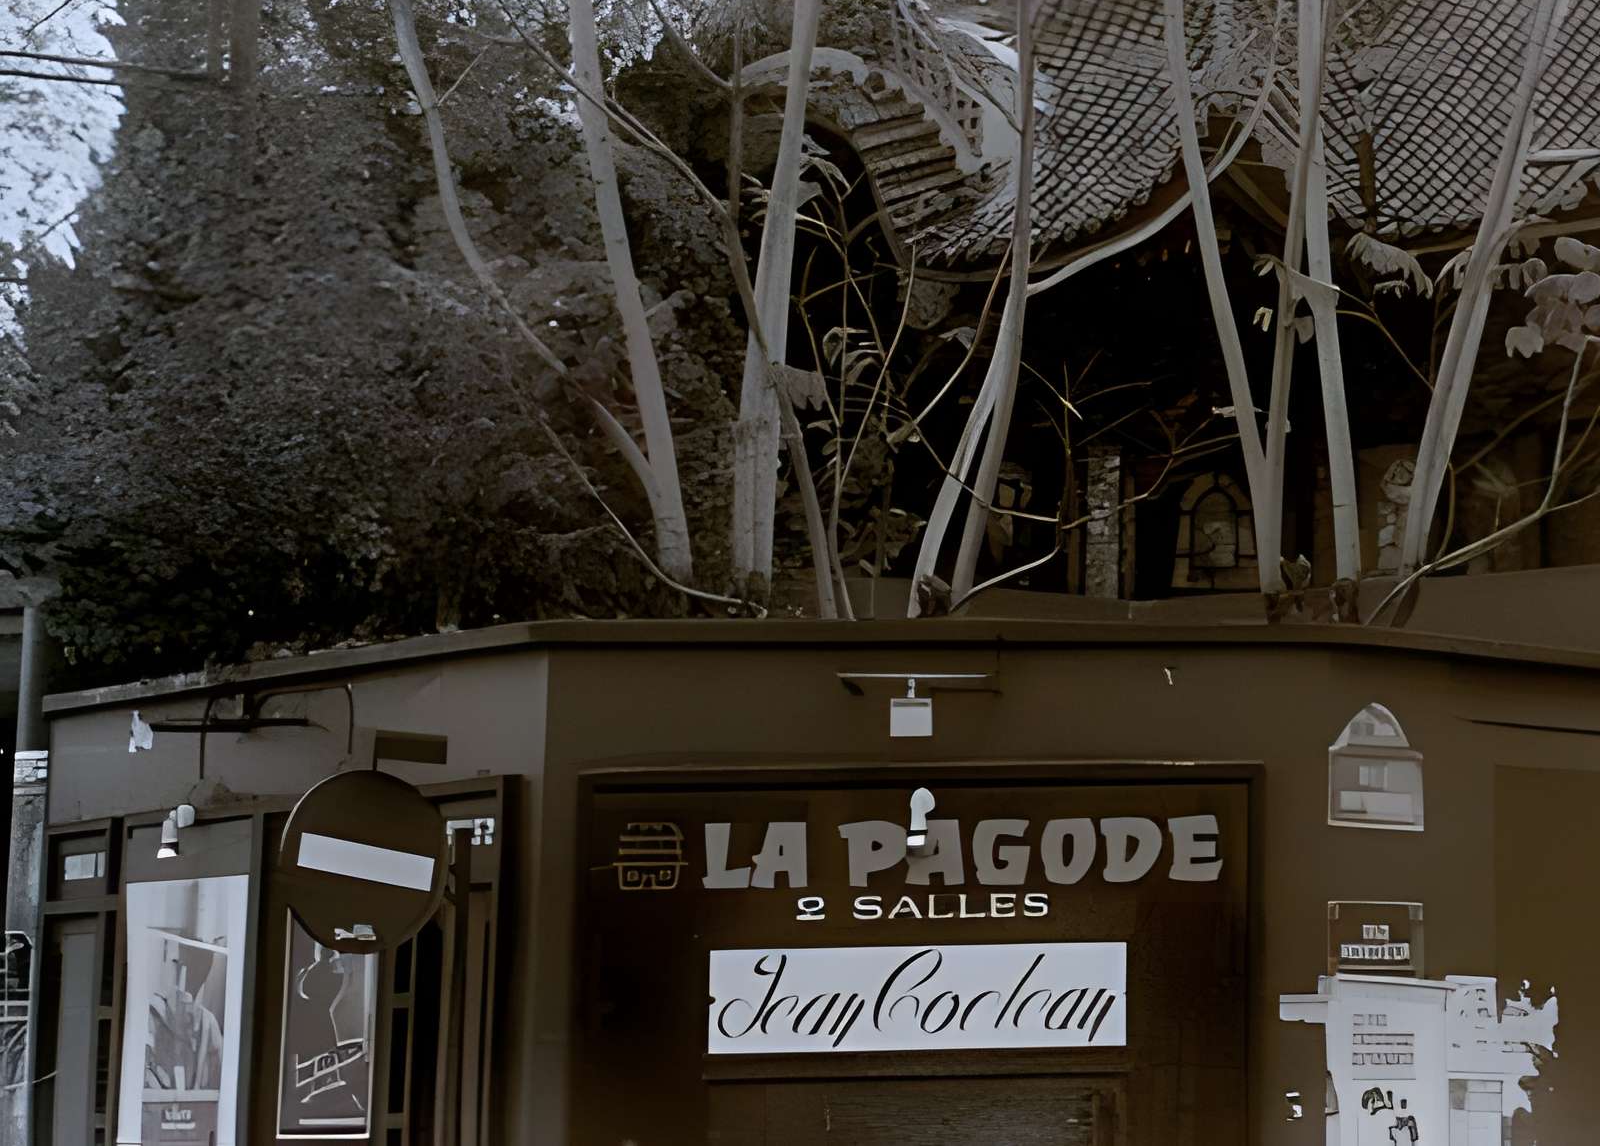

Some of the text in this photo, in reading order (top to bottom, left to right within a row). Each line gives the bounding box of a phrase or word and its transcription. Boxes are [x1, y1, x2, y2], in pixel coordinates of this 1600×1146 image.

[702, 815, 1224, 888] LA PAGODE
[852, 893, 1049, 919] SALLES
